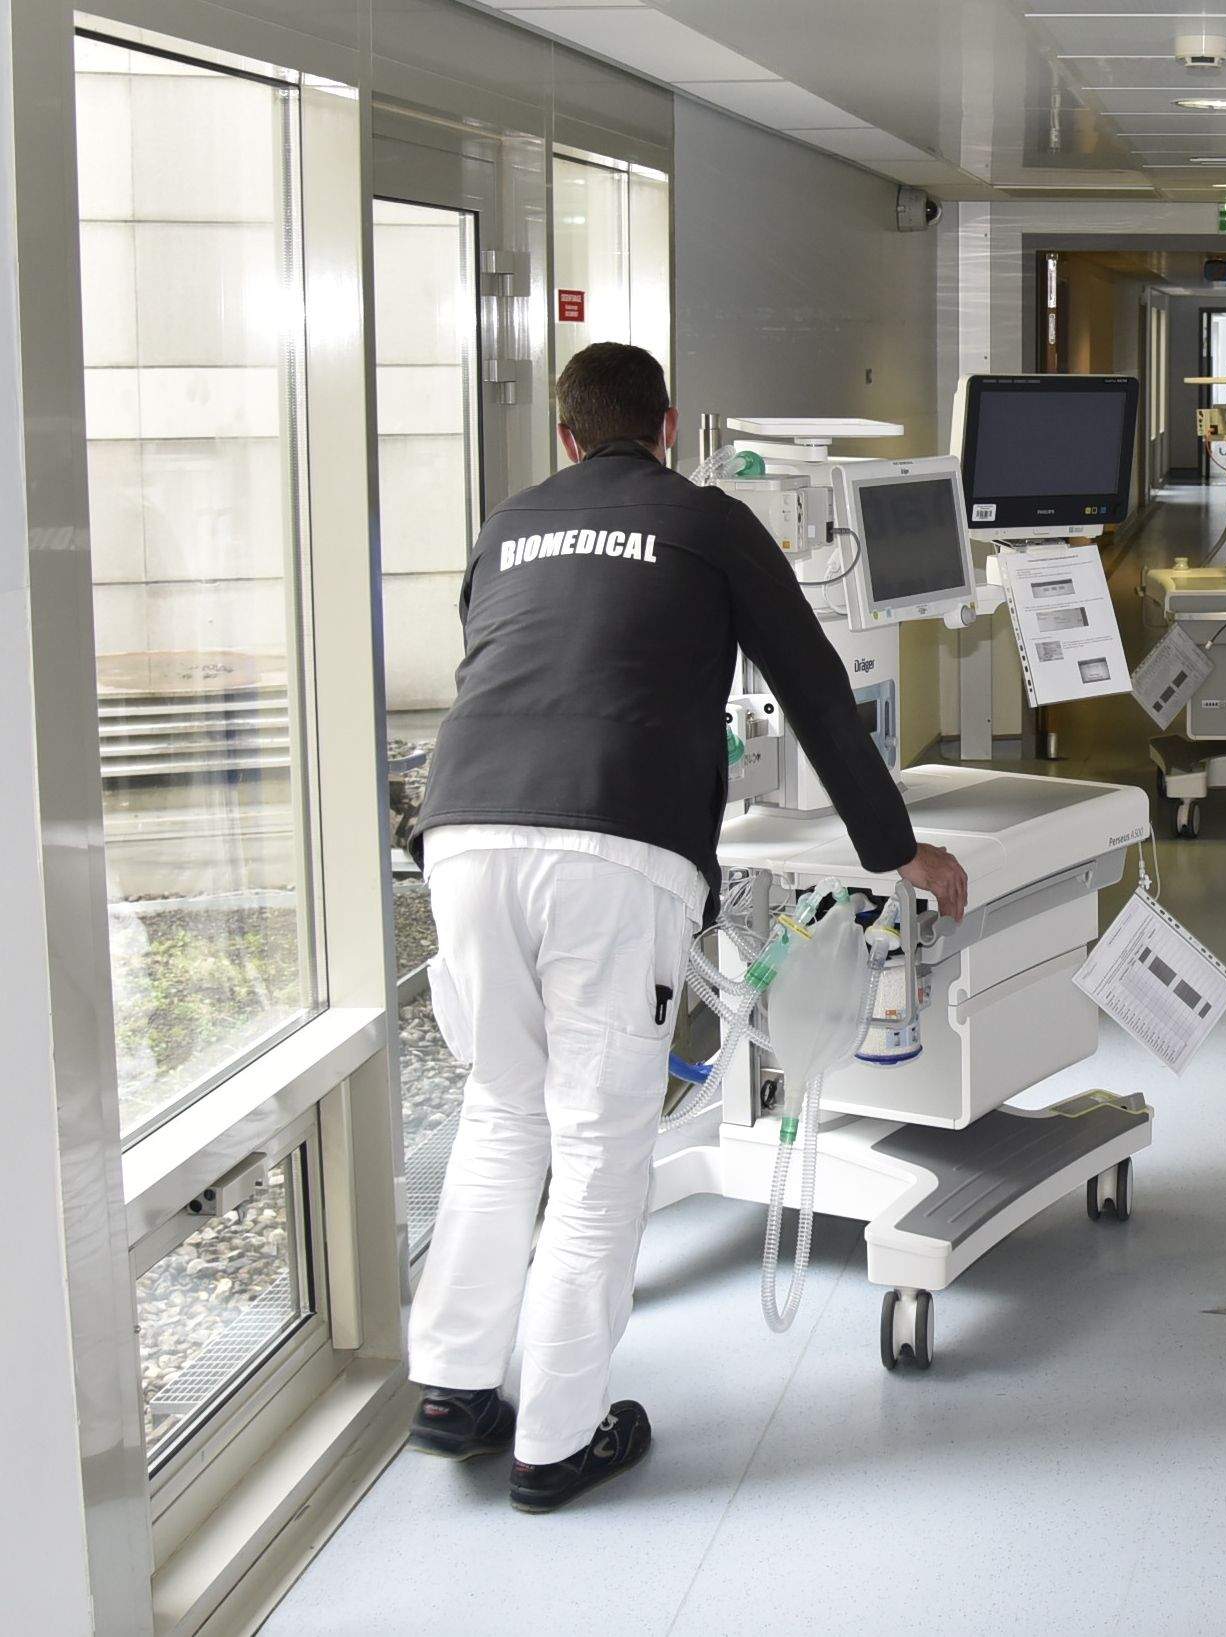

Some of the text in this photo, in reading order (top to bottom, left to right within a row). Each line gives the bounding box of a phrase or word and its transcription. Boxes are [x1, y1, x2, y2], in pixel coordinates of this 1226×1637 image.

[500, 529, 657, 572] BIOMEDICAL
[854, 658, 876, 673] Dräger
[1108, 833, 1130, 847] Perseus
